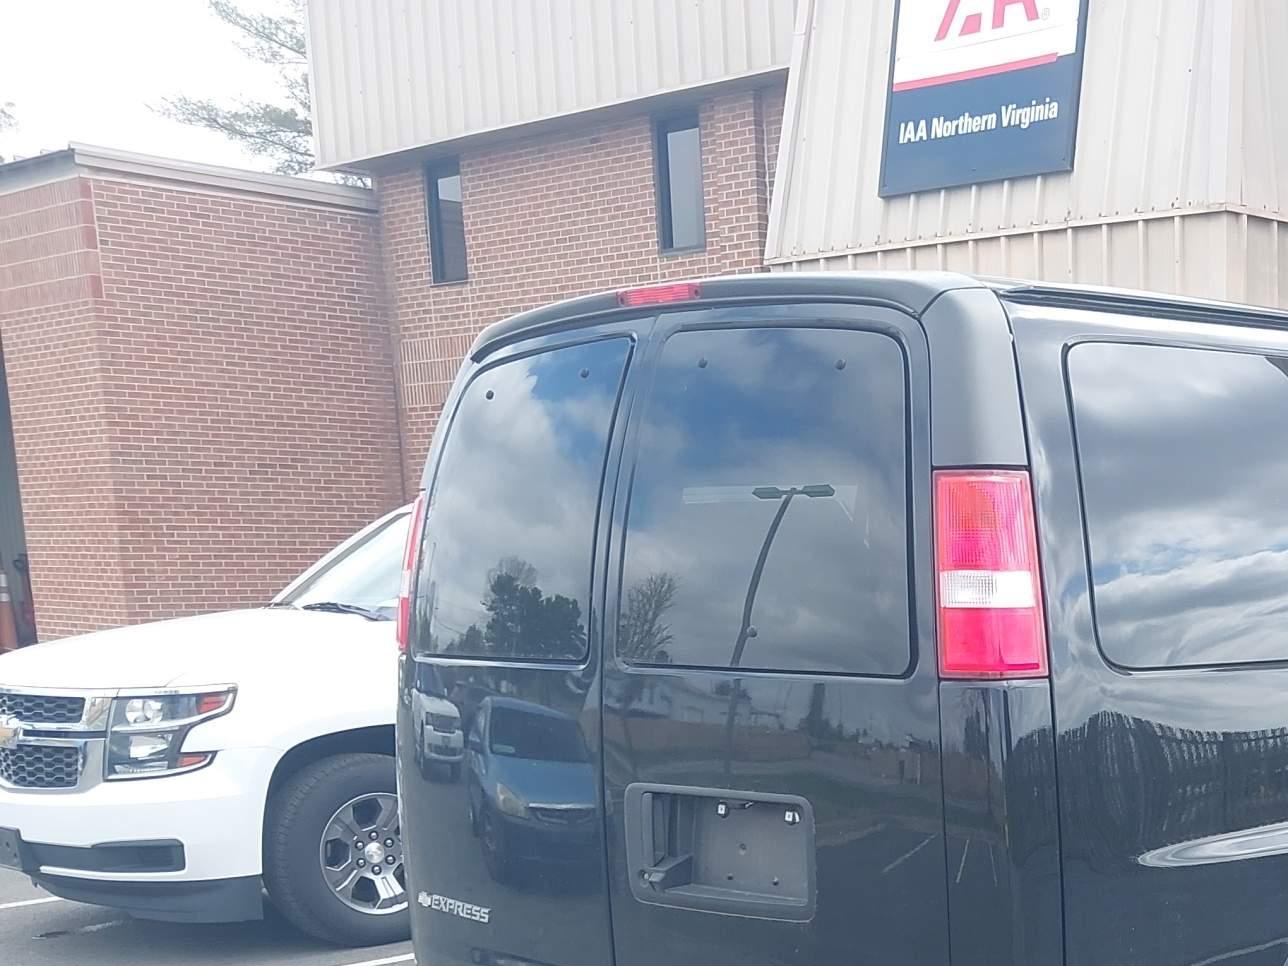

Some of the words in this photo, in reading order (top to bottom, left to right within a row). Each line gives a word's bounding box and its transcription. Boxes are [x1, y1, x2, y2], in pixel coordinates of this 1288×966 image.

[898, 117, 928, 144] IAA
[930, 111, 997, 140] Northern
[1001, 97, 1059, 129] Virginia
[431, 894, 492, 923] EXPRESS
